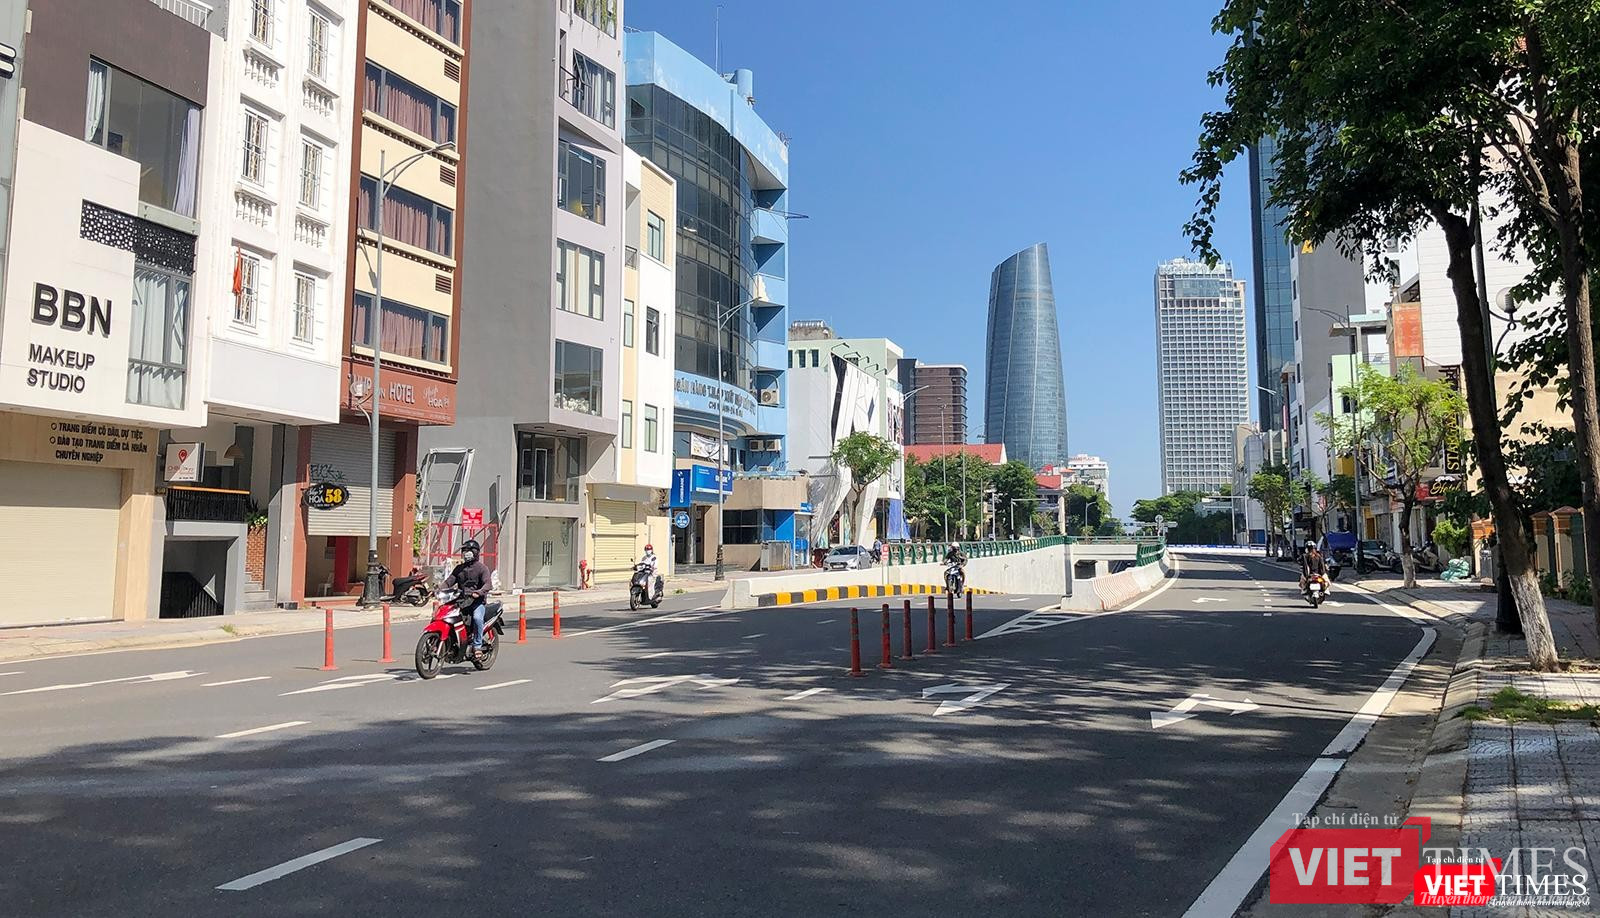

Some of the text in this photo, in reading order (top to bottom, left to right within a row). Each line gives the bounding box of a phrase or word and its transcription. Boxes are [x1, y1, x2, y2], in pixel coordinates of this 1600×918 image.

[32, 282, 112, 338] BBN
[28, 343, 95, 371] MAKEUP
[27, 368, 85, 393] STUDIO
[389, 382, 416, 404] HOTEL
[58, 422, 80, 434] TRANG
[85, 438, 105, 450] TRANG
[325, 488, 343, 503] 58
